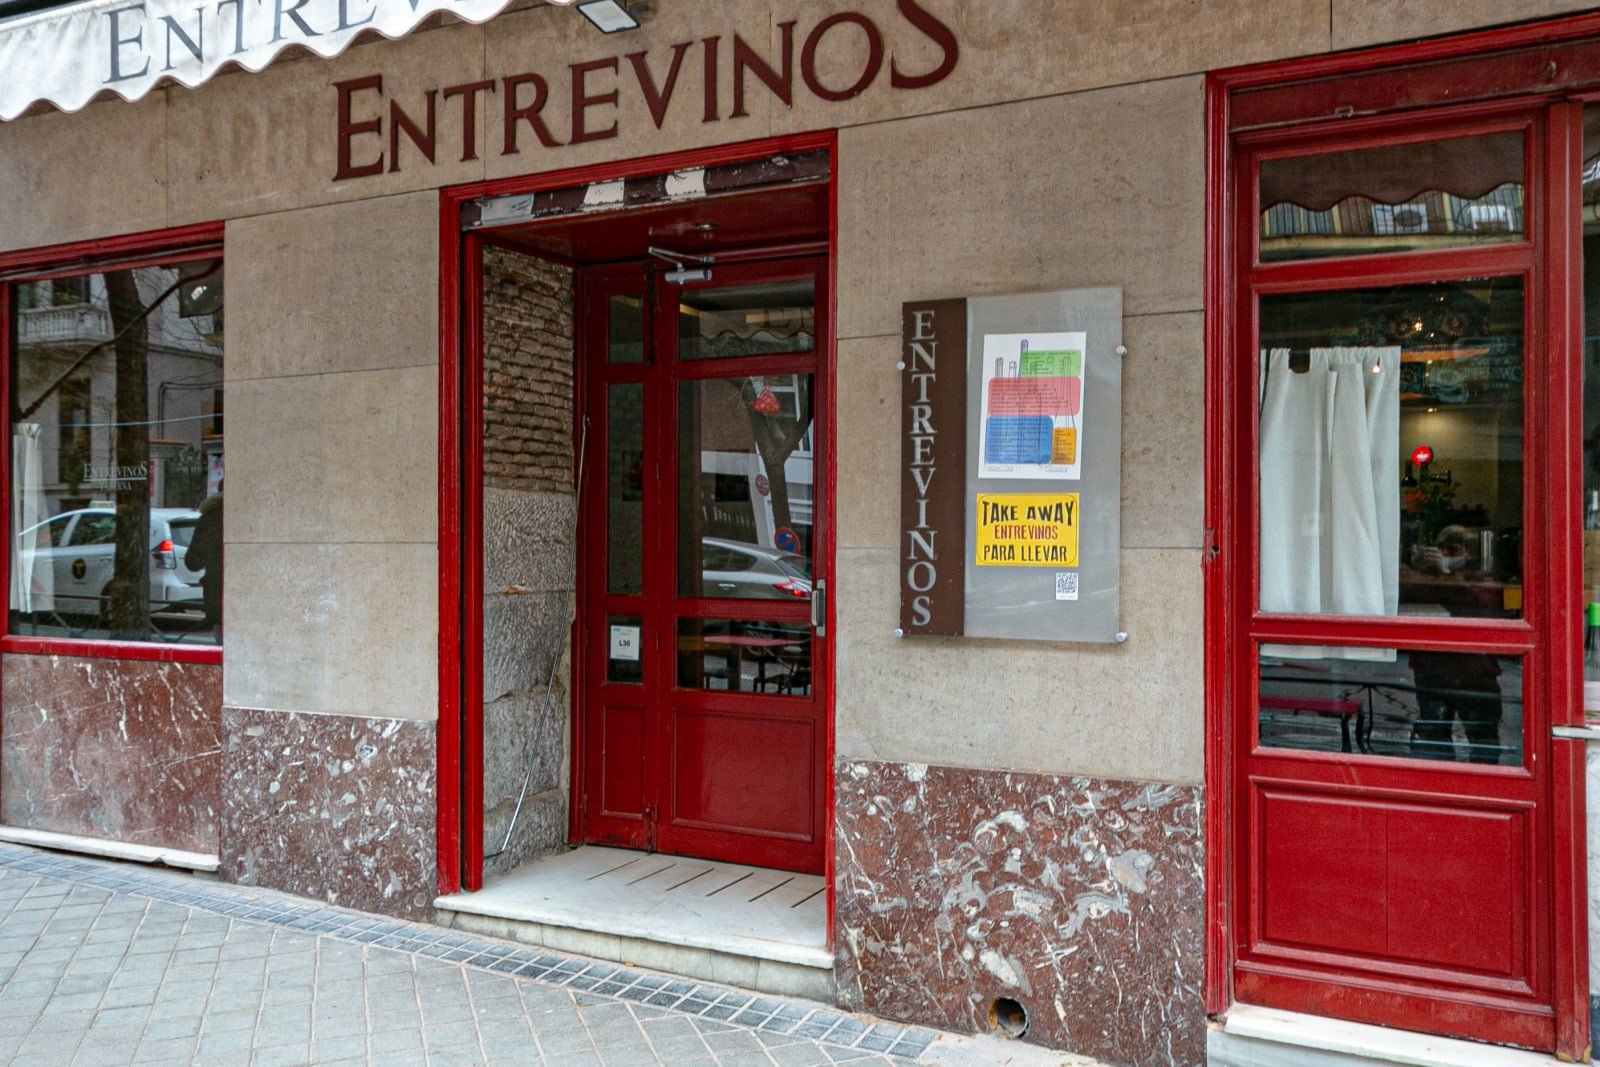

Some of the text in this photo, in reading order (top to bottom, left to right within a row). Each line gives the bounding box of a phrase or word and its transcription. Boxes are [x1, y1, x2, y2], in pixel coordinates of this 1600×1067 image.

[102, 0, 420, 84] ENTRE
[332, 0, 959, 181] ENTREVINOS
[907, 310, 938, 626] ENTREVINOS
[982, 500, 1074, 526] TAKE AWAY
[994, 525, 1058, 540] ENTREVINOS
[983, 544, 1067, 562] PARA LLEVAR
